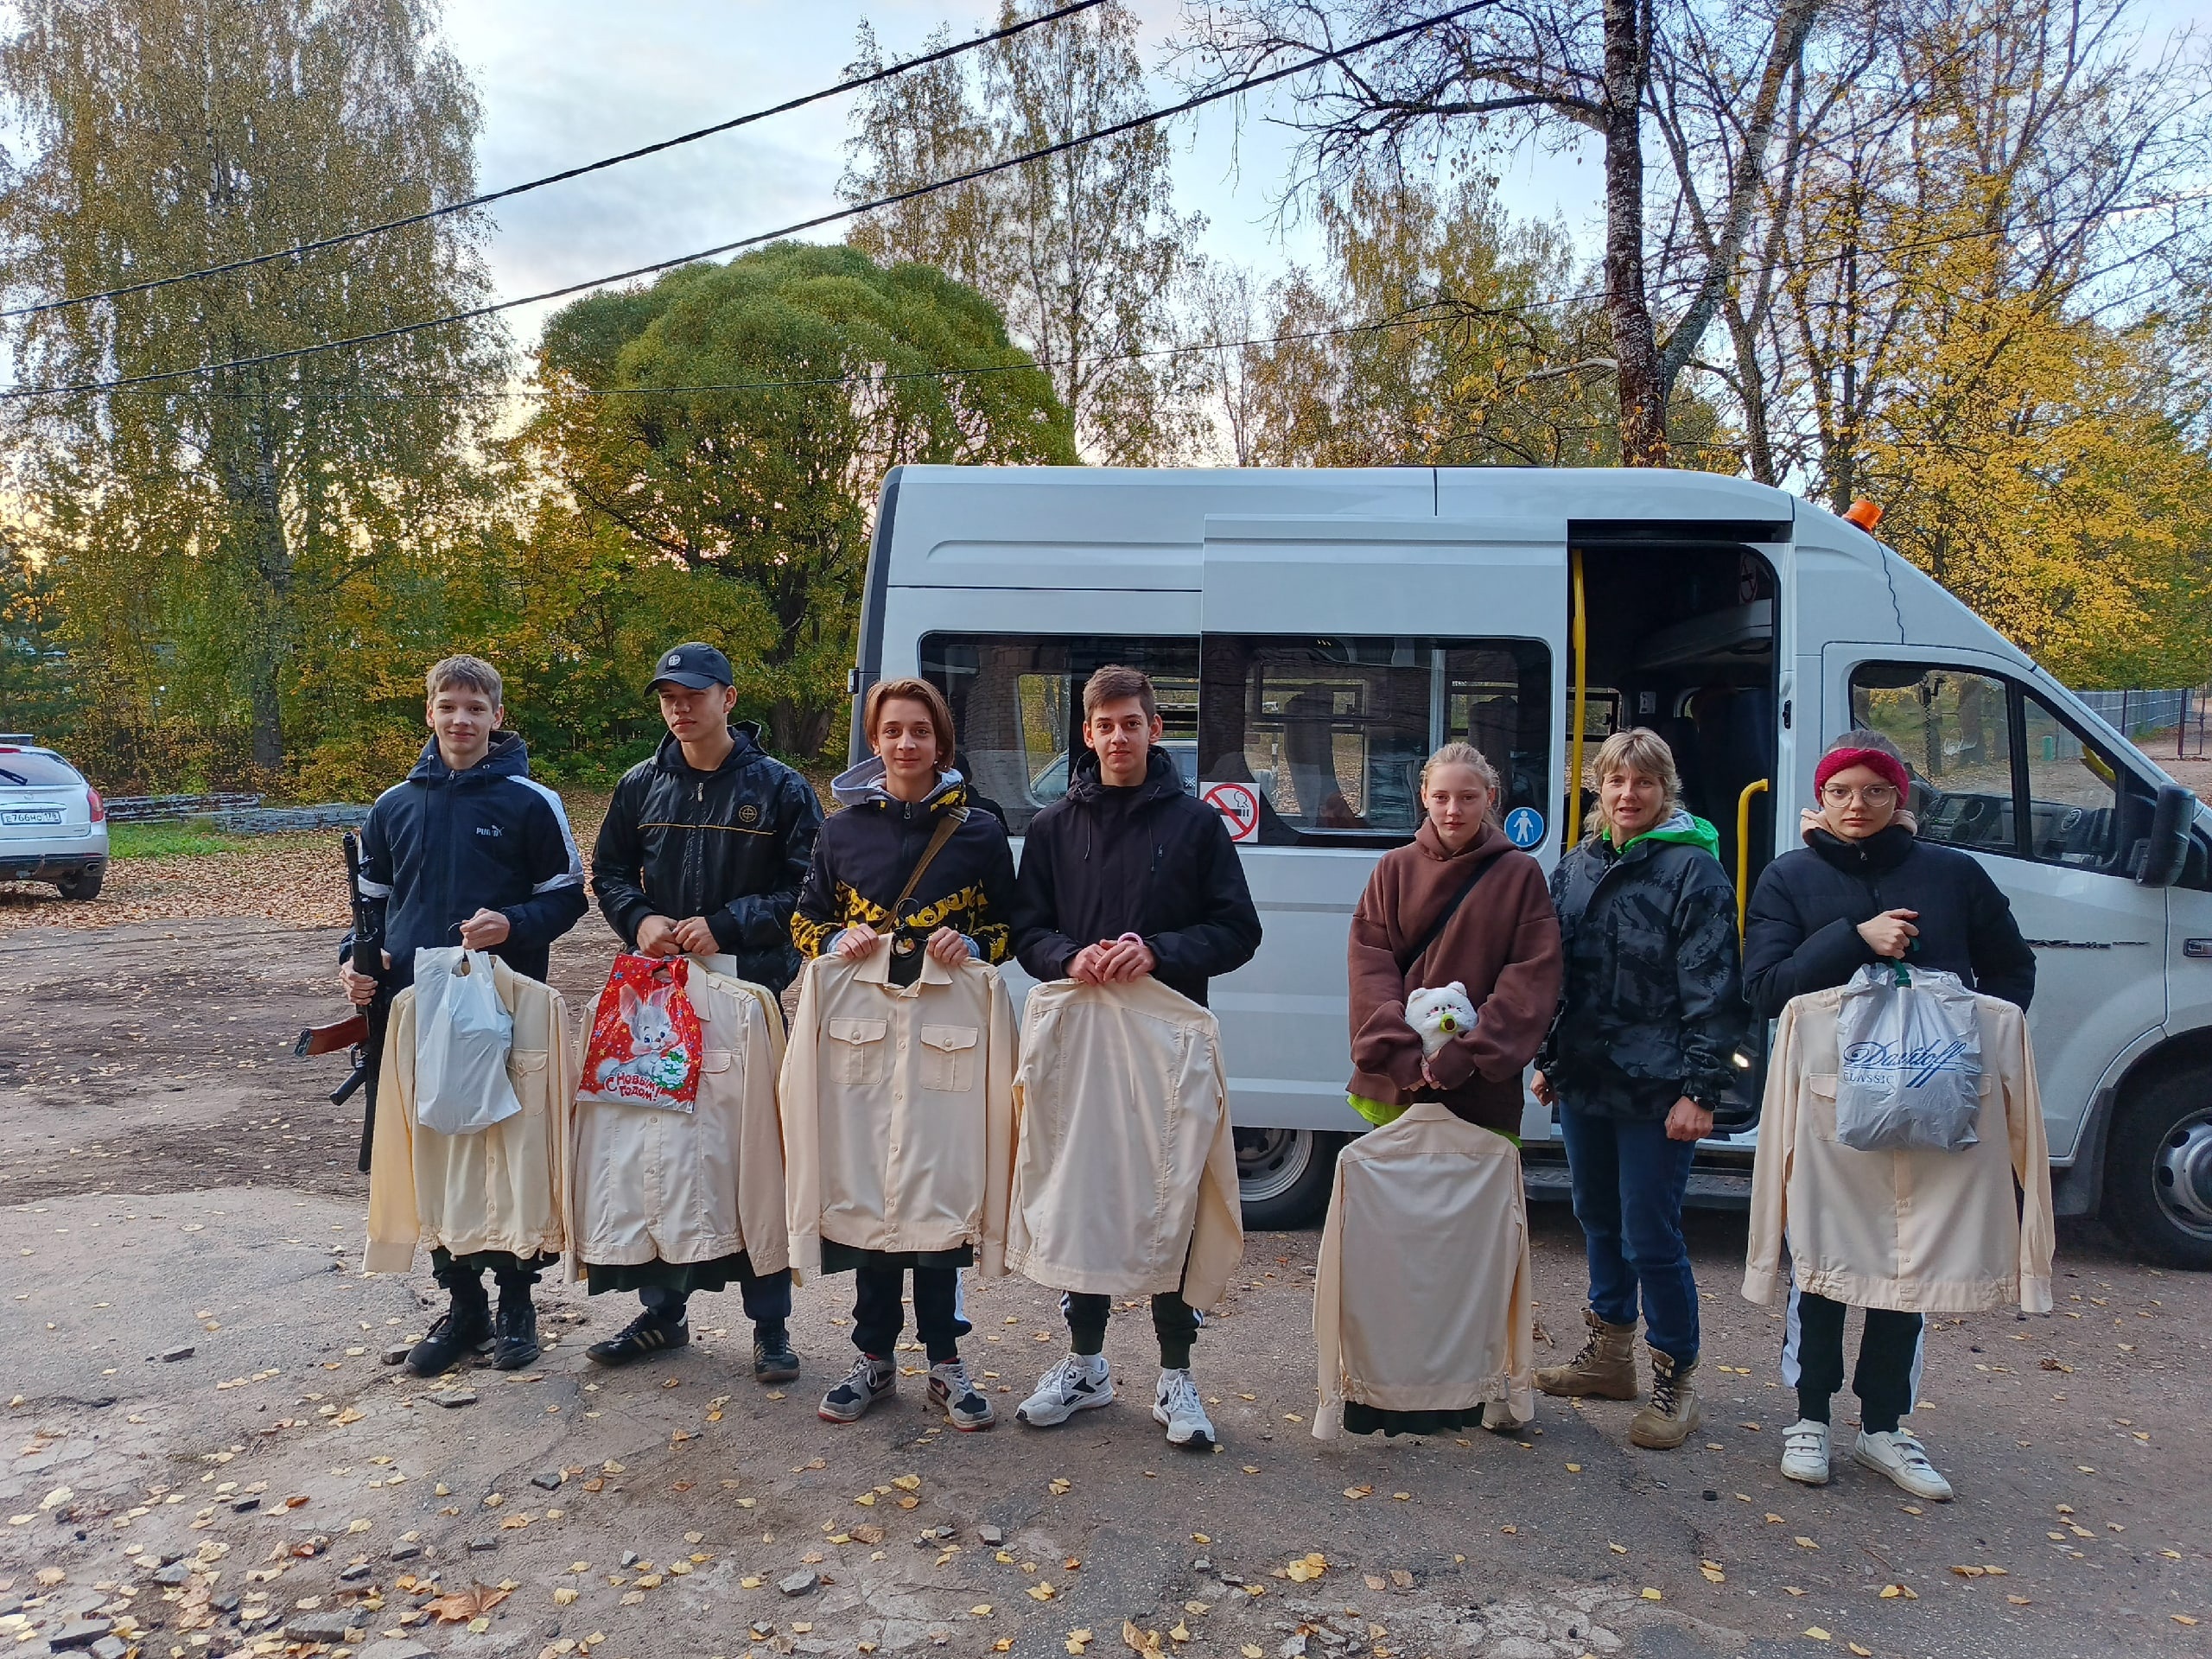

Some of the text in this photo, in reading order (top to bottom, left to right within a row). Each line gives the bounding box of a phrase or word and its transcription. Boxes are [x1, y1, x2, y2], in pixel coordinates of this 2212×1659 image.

[1843, 1039, 1967, 1088] Davidoff
[606, 1077, 618, 1091] С
[1843, 1072, 1895, 1084] CLASSIC
